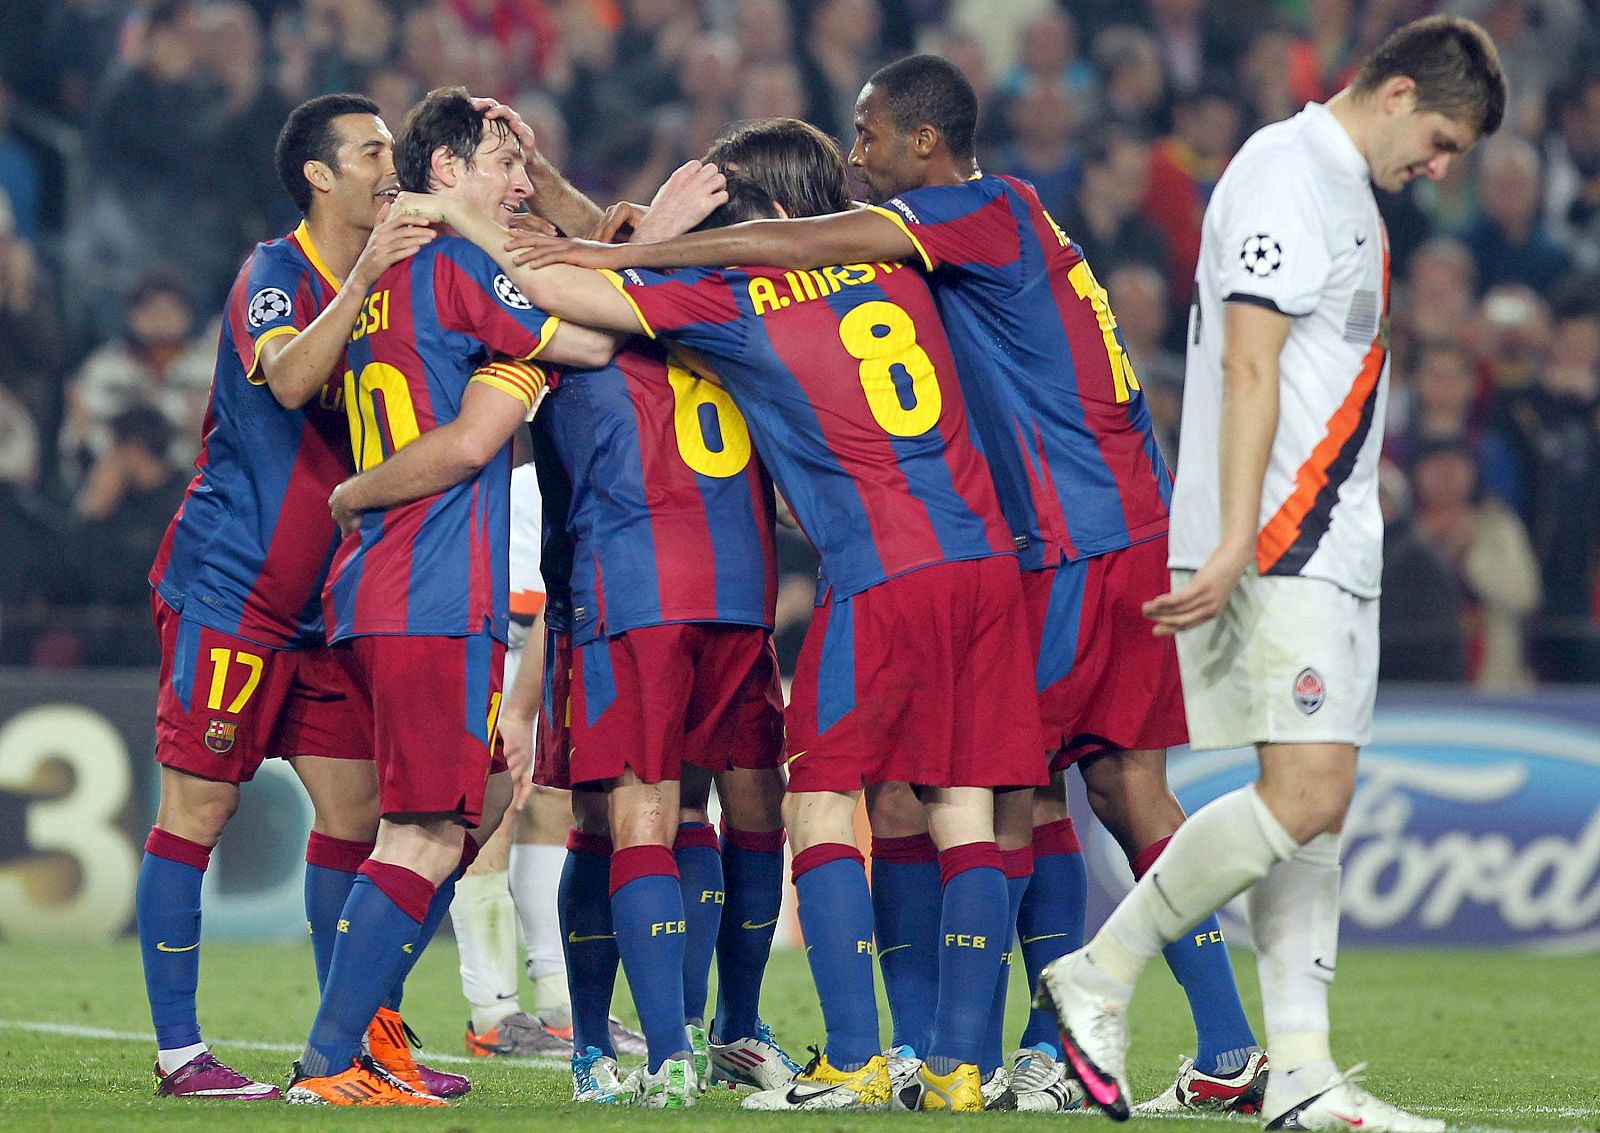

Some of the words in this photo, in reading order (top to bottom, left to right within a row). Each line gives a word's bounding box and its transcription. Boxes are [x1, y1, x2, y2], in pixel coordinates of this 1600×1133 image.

[839, 300, 942, 437] 8
[207, 647, 264, 714] 17
[651, 920, 686, 937] FCB
[945, 934, 987, 949] FCB
